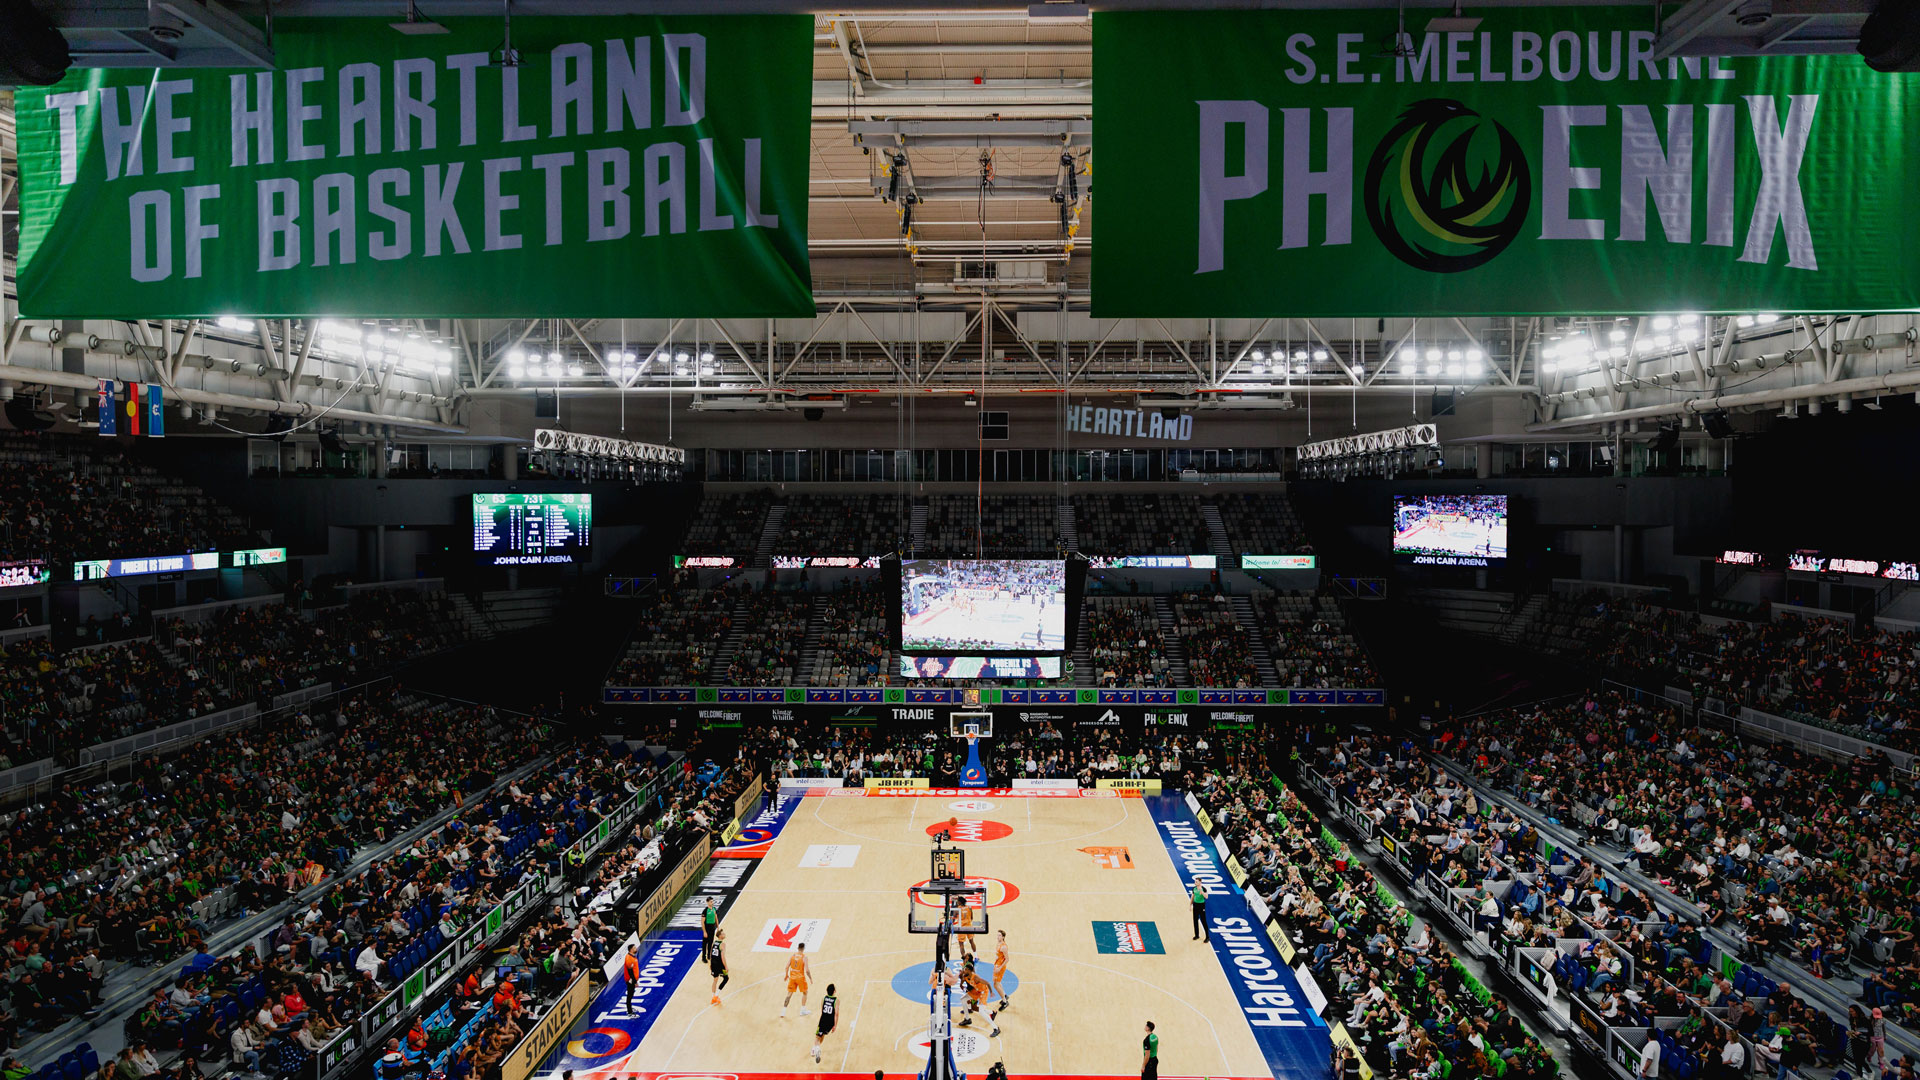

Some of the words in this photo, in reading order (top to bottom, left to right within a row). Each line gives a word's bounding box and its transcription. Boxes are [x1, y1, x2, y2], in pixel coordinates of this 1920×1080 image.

[1285, 33, 1381, 84] S.E.
[45, 79, 194, 186] THE
[229, 33, 707, 168] HEARTLAND
[129, 184, 220, 283] OF
[256, 137, 779, 274] BASKETBALL
[1066, 405, 1193, 441] HEARTLAND
[523, 494, 543, 504] 7:31
[494, 557, 519, 565] JOHN
[520, 556, 541, 564] CAIN
[543, 555, 573, 563] ARENA
[1413, 556, 1435, 565] JOHN
[1436, 557, 1457, 566] CAIN
[1458, 558, 1488, 566] ARENA
[990, 658, 1020, 668] PHOENIX
[1021, 658, 1031, 668] VS
[699, 710, 723, 719] WELCOME
[723, 712, 741, 721] FIREPIT
[892, 708, 934, 720] TRADIE
[1210, 712, 1236, 720] WELCOME
[1235, 714, 1254, 722] FIREPIT
[683, 842, 706, 880] STANLEY
[1159, 821, 1230, 895] Homecourt
[645, 880, 673, 925] STANLEY
[594, 942, 684, 1024] Tyrepower
[1209, 917, 1307, 1027] Harcourts
[822, 1004, 833, 1015] 30
[525, 994, 574, 1069] STANLEY
